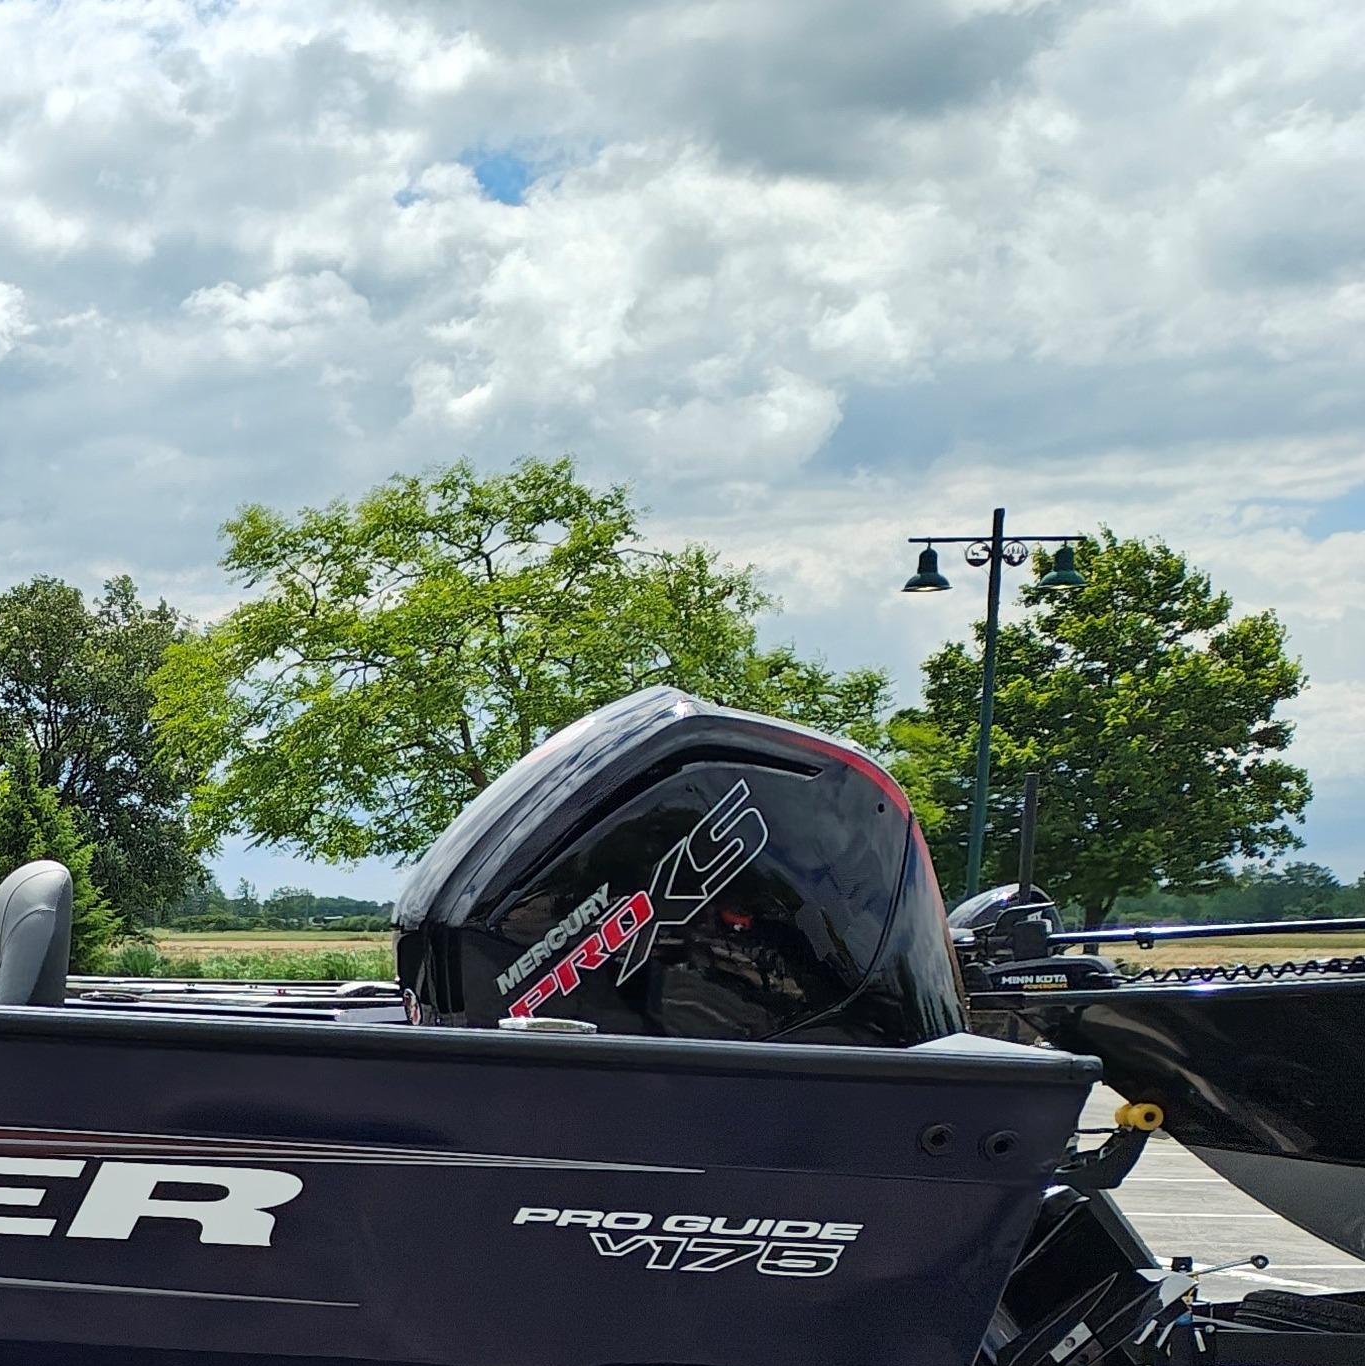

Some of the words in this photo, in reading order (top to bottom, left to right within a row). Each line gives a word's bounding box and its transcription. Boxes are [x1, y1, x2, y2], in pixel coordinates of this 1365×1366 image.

[508, 889, 655, 1018] PRO
[597, 778, 769, 987] XS
[495, 882, 611, 996] MERCURY
[1001, 976, 1034, 984] MINN
[1035, 974, 1068, 983] KOTA
[513, 1207, 653, 1230] PRO
[662, 1215, 864, 1241] GUIDE
[589, 1232, 845, 1277] V175
